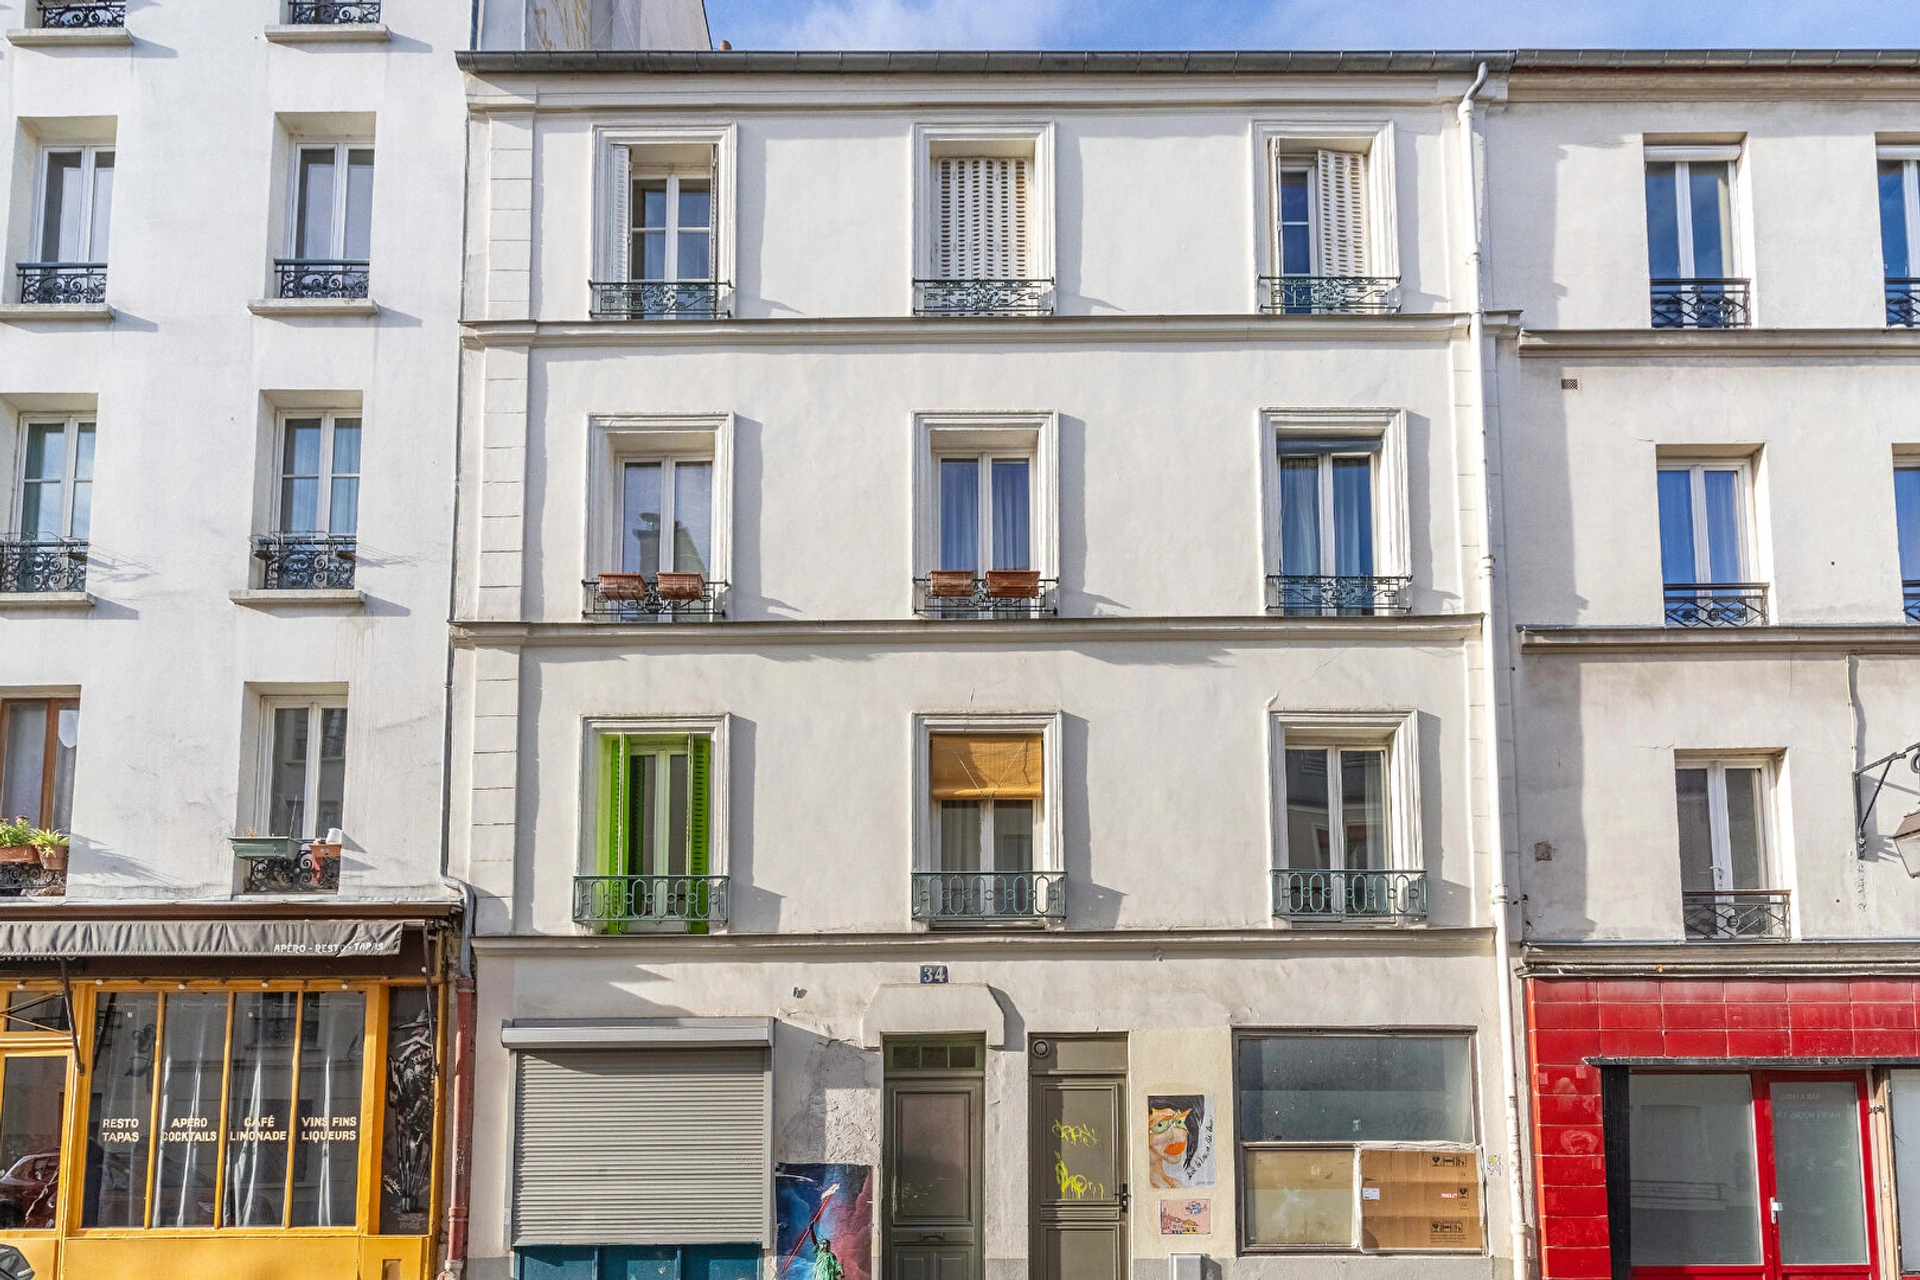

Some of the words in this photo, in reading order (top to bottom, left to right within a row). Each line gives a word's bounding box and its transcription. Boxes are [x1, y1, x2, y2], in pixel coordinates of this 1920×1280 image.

[274, 941, 306, 954] APÉRO
[354, 942, 384, 952] TAPAS
[924, 966, 945, 983] 34
[102, 1118, 139, 1129] RESTO
[244, 1115, 275, 1127] CAFÉ
[302, 1116, 329, 1127] VINS
[332, 1116, 357, 1127] FINS
[102, 1131, 139, 1142] TAPAS
[162, 1131, 217, 1142] COCKTAILS
[230, 1130, 287, 1141] LIMONADE
[302, 1130, 357, 1143] LIQUEURS
